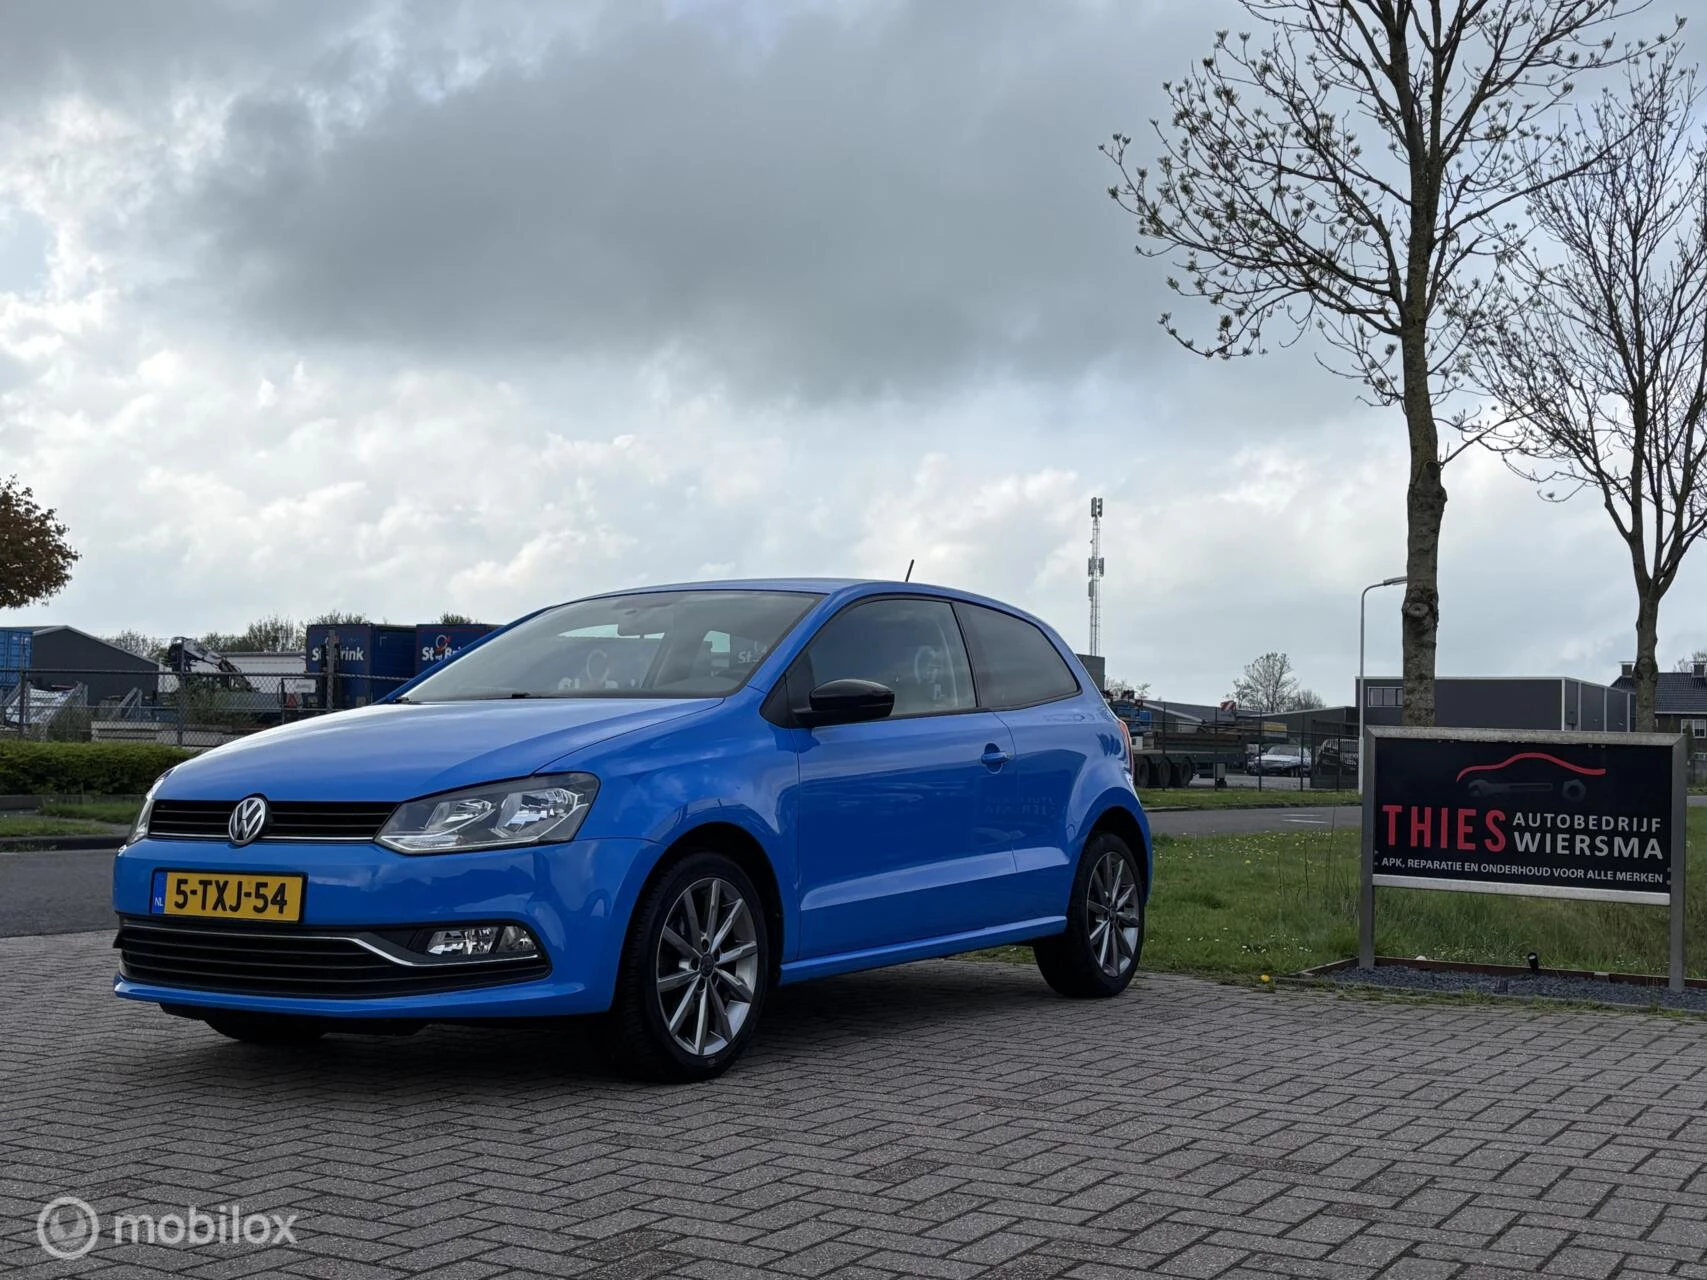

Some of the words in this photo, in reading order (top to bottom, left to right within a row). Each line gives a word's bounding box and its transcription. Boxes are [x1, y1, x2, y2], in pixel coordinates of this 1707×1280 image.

[1382, 804, 1507, 853] THIES
[1512, 811, 1662, 834] AUTOBEDRIJF
[1513, 830, 1664, 860] WIERSMA
[1381, 857, 1406, 868] APK,
[1407, 858, 1463, 872] REPARATIE
[1464, 862, 1479, 872] EN
[1480, 863, 1551, 877] ONDERHOUD
[1552, 867, 1585, 879] VOOR
[1586, 869, 1614, 881] ALLE
[1615, 871, 1664, 883] MERKEN
[154, 896, 164, 907] NL
[174, 877, 288, 915] 5-TXJ-54
